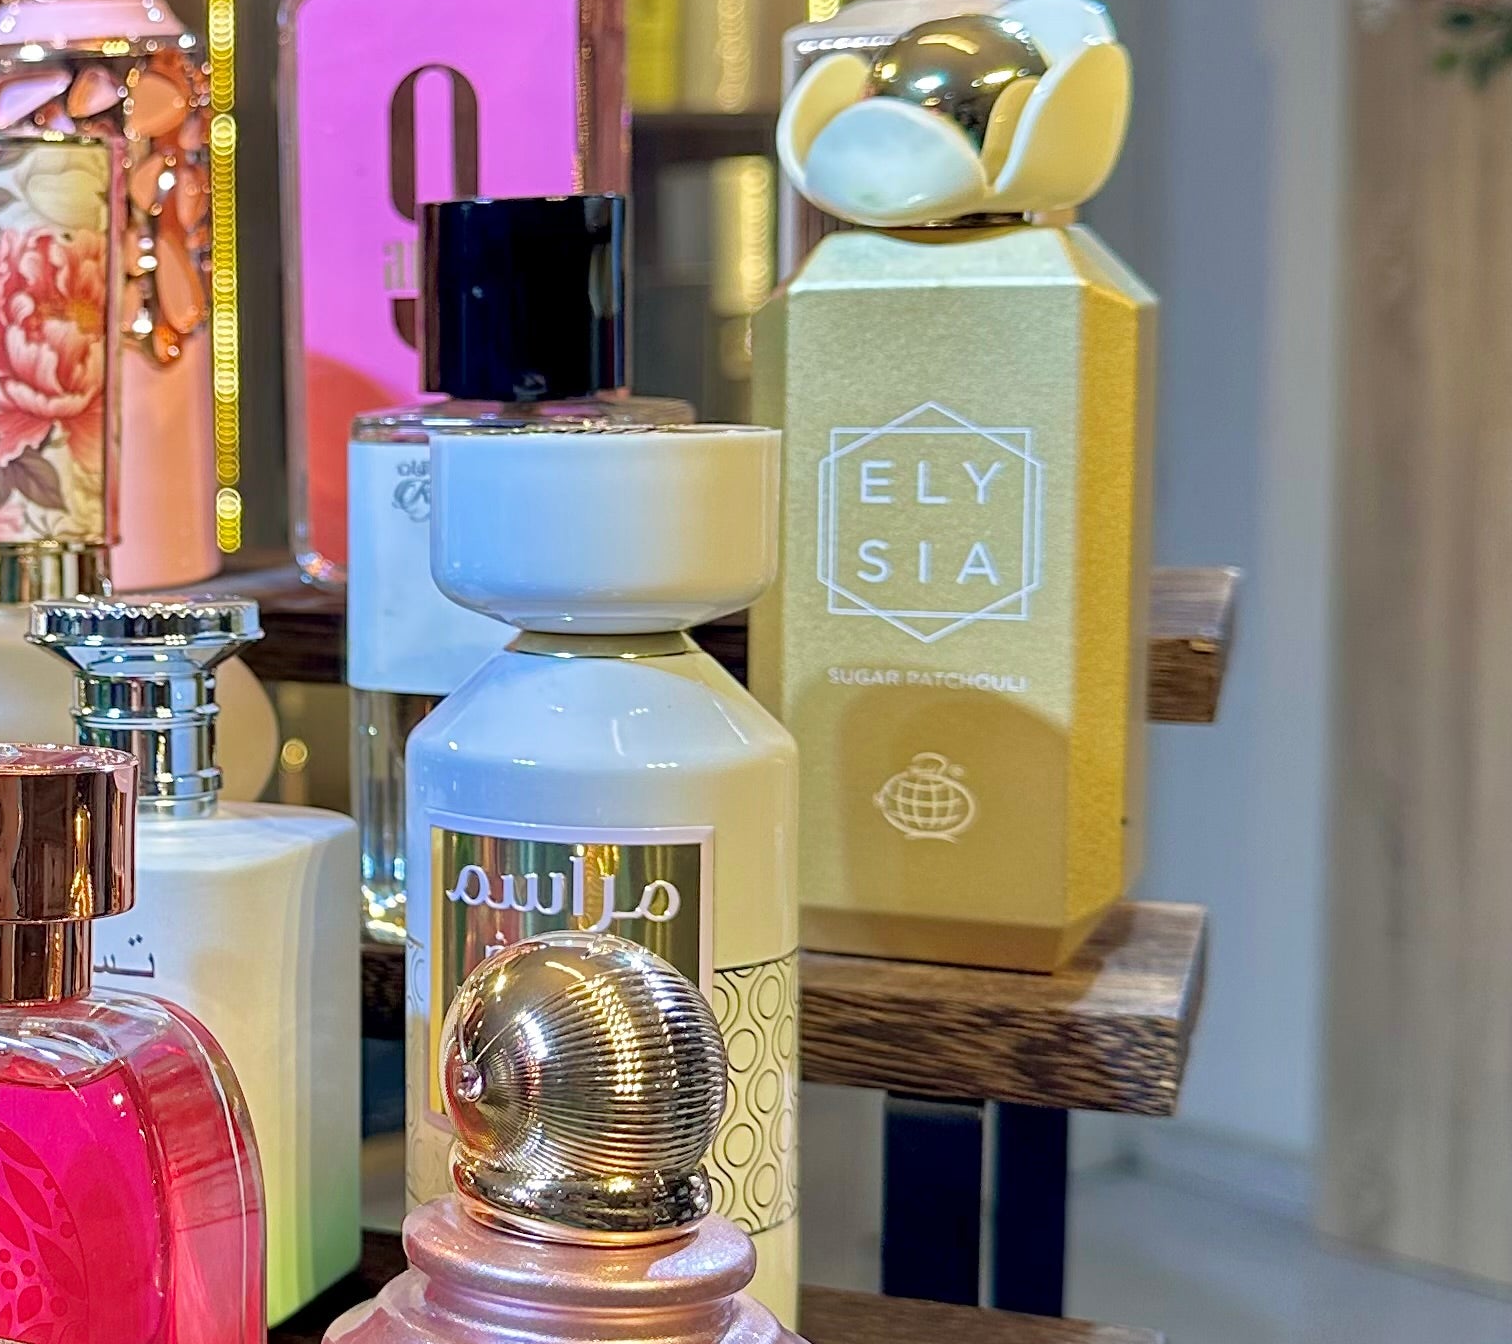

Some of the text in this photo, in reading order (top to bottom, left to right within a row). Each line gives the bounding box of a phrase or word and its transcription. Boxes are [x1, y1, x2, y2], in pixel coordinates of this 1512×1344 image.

[860, 460, 1006, 506] ELY
[856, 539, 1001, 586] SIA
[827, 666, 1028, 693] SUGAR PATCHOULI
